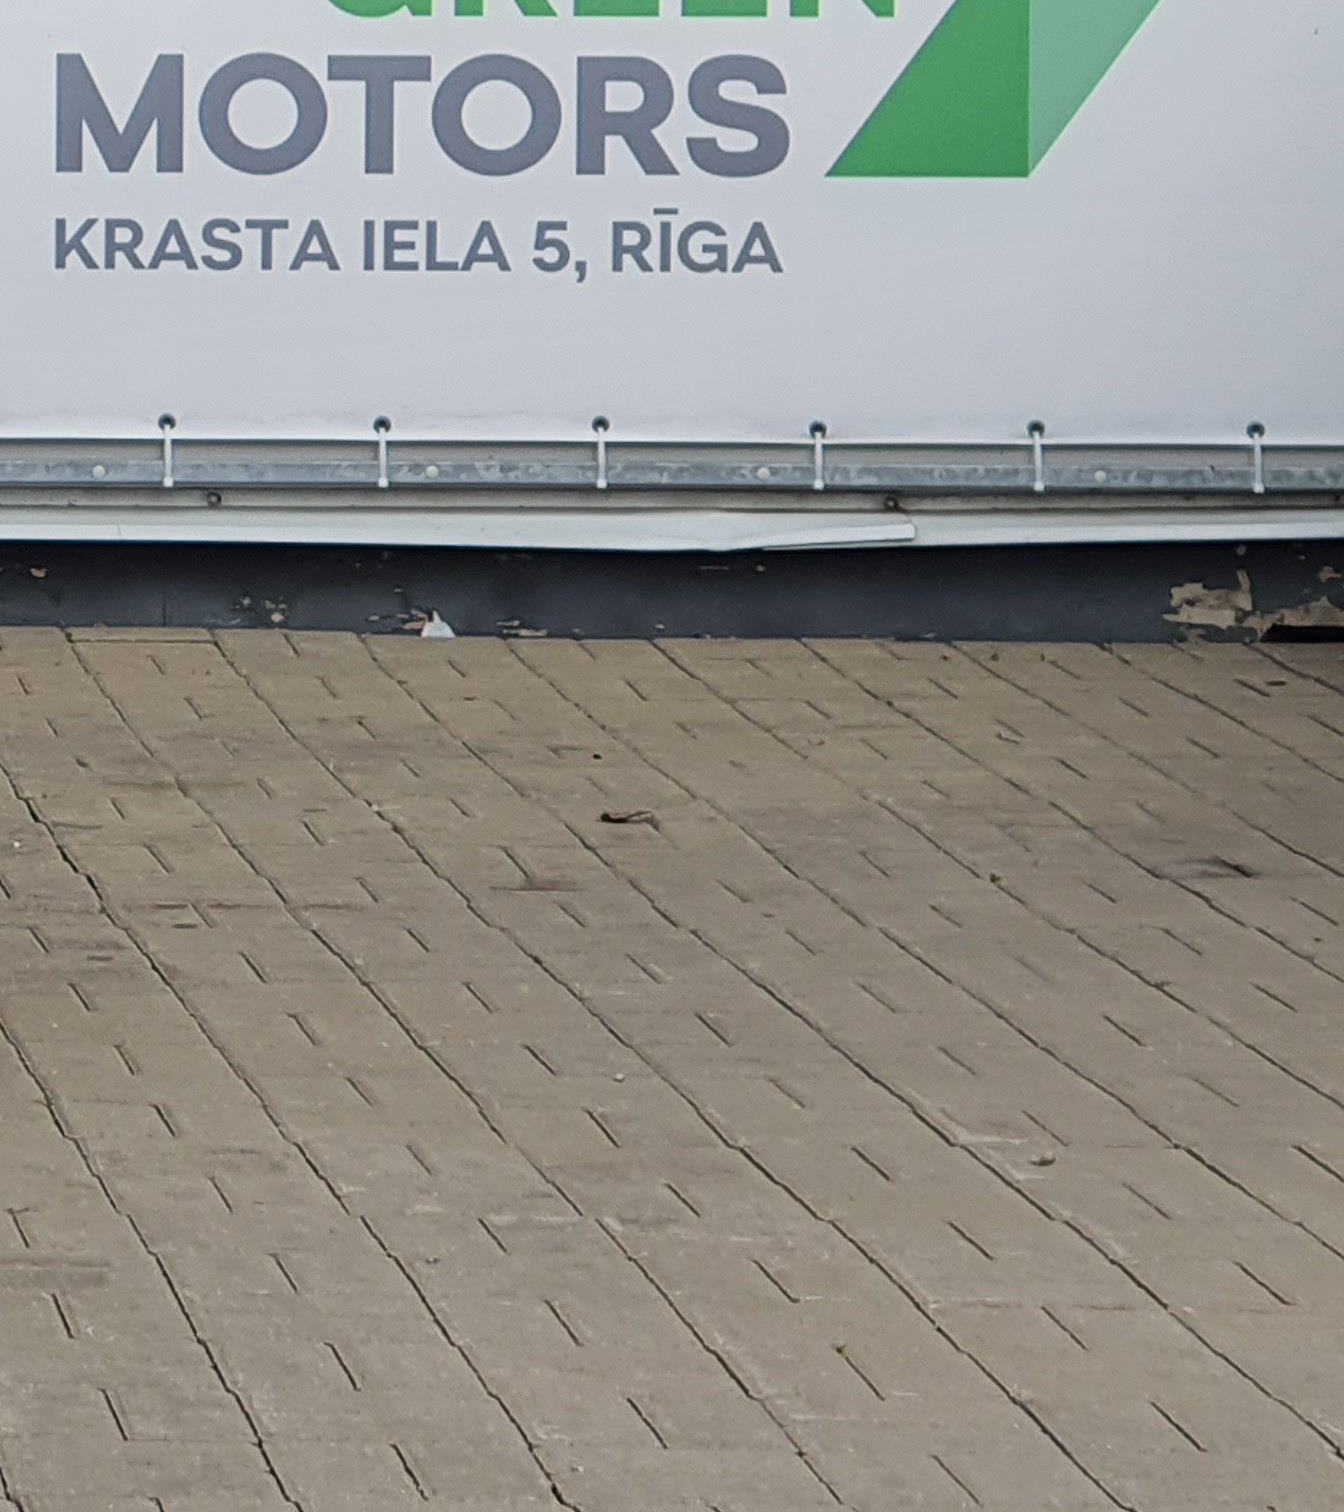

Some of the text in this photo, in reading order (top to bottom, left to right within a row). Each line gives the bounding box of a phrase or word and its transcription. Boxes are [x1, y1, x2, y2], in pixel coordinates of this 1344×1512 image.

[55, 52, 791, 178] MOTORS
[53, 207, 784, 284] KRASTA IELA 5, RĪGA
